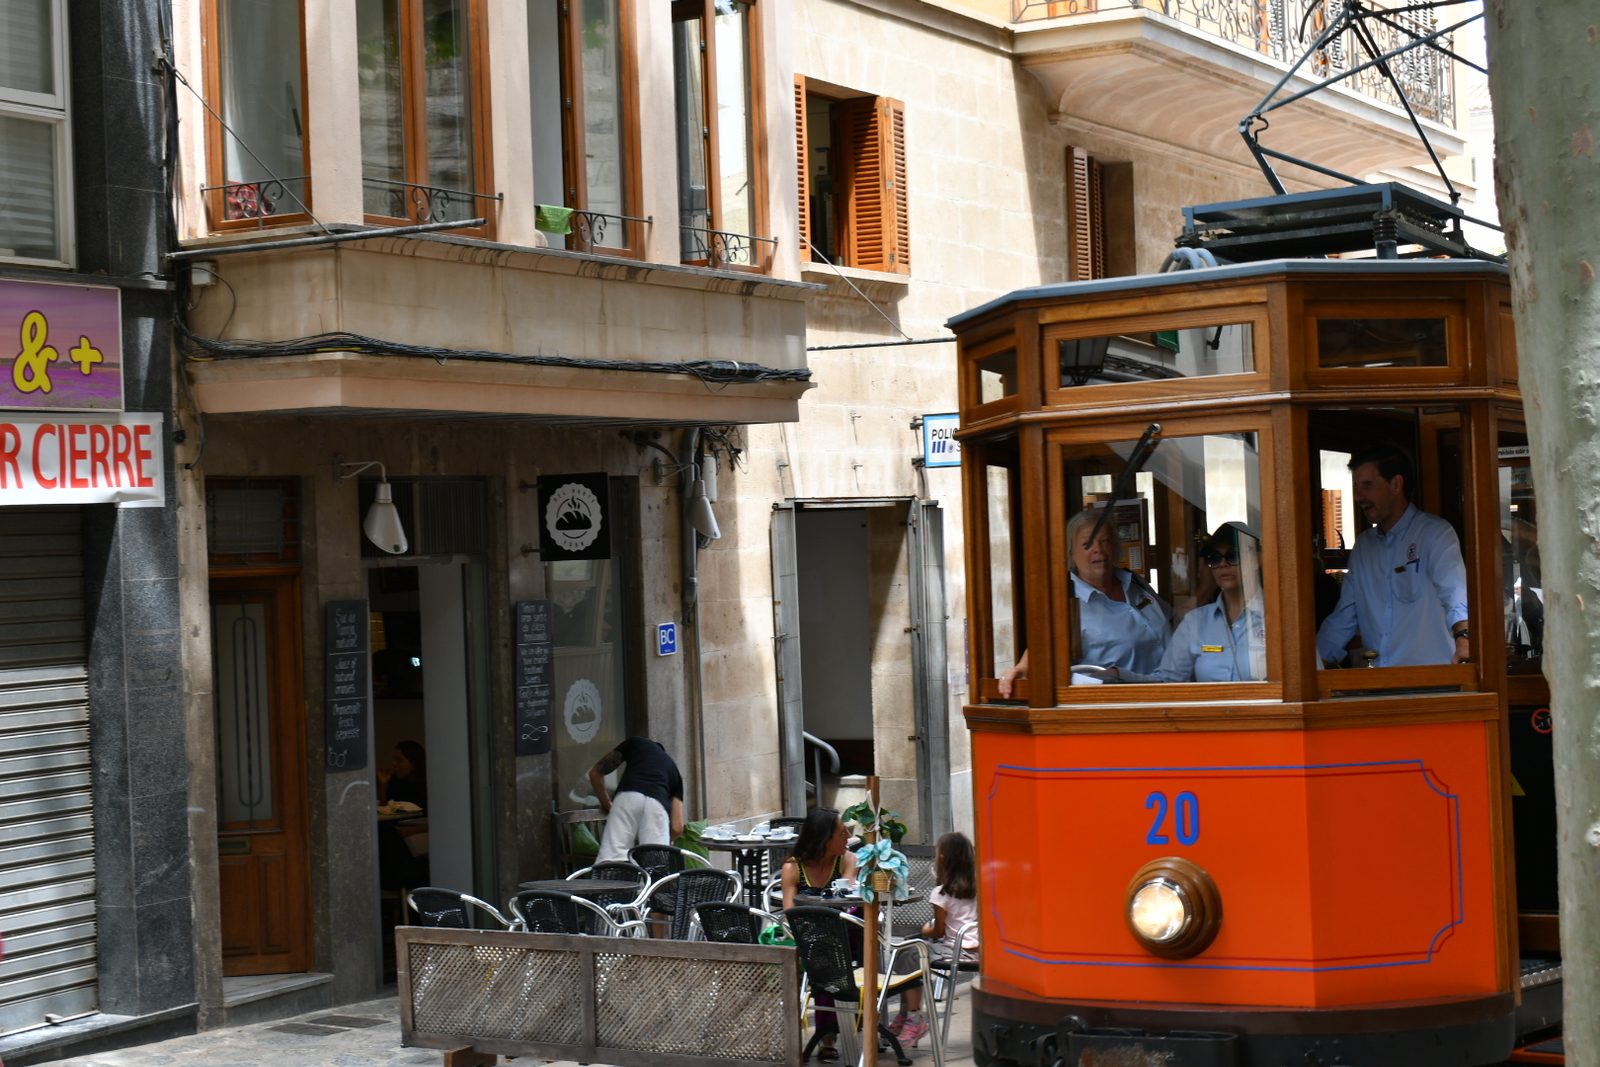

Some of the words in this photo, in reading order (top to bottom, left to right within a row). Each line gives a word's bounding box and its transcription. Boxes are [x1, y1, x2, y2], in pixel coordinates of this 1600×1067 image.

[32, 423, 153, 489] CIERRE
[660, 628, 675, 645] BC
[1145, 791, 1199, 846] 20
